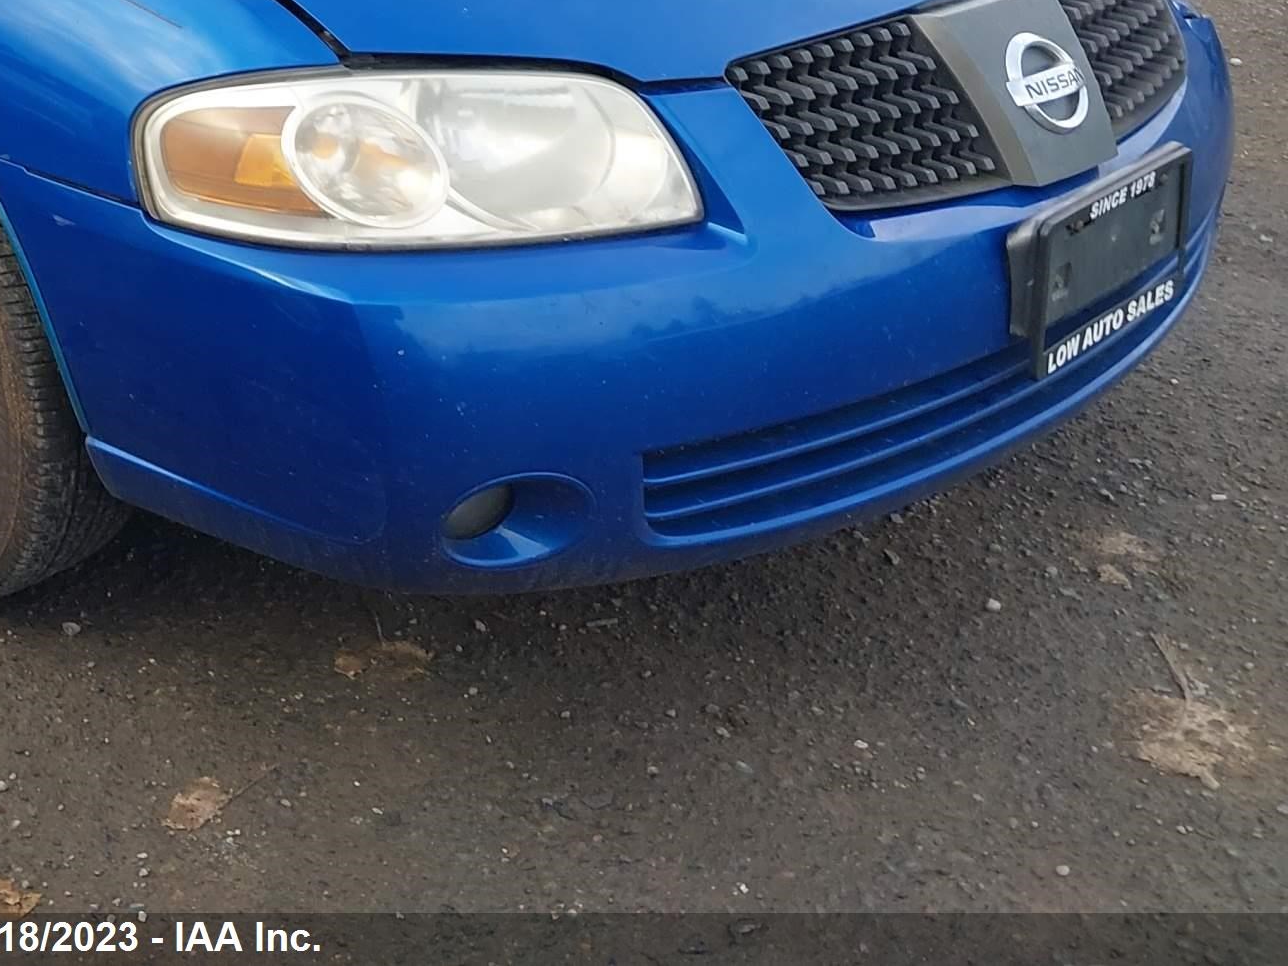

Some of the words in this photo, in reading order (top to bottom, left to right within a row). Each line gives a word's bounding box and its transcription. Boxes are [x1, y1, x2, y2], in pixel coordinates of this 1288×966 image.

[1024, 68, 1086, 100] NISSAN
[1089, 187, 1127, 220] SINCE
[1047, 340, 1080, 375] LOW
[1081, 308, 1124, 353] AUTO
[1126, 279, 1175, 323] SALES
